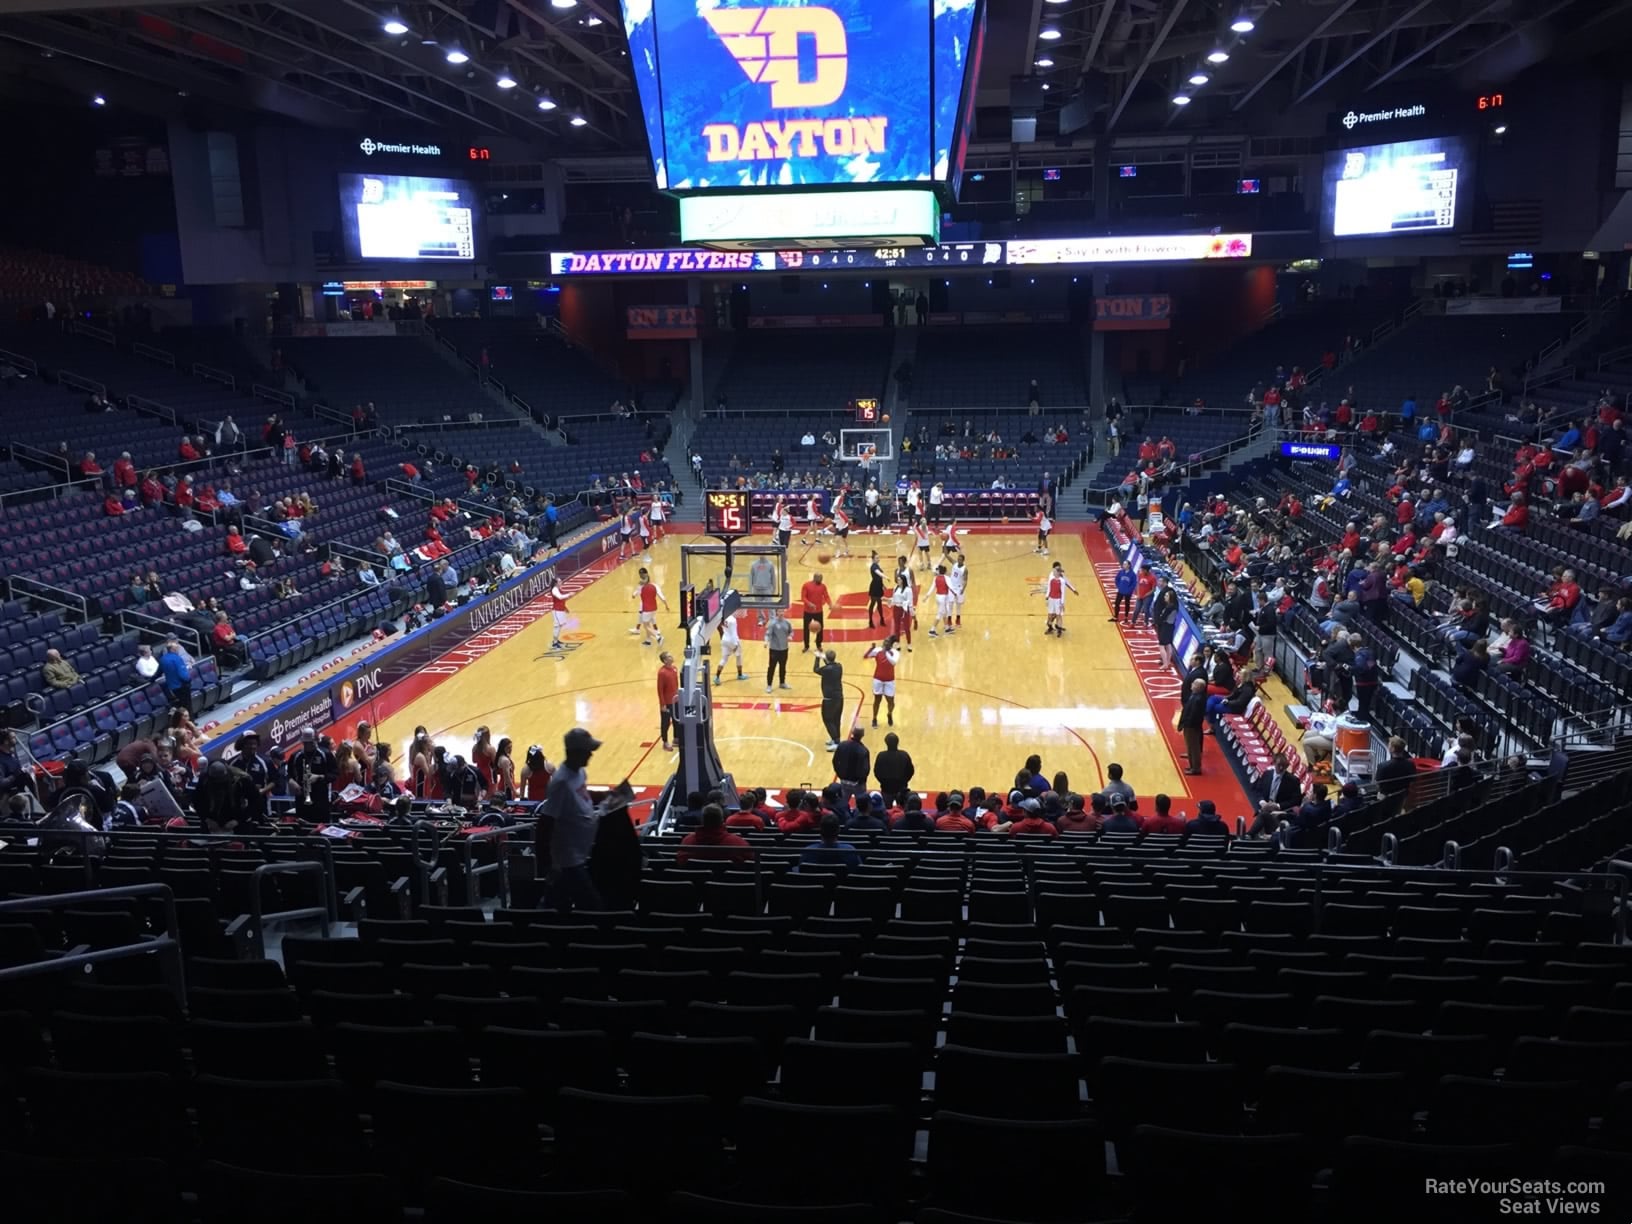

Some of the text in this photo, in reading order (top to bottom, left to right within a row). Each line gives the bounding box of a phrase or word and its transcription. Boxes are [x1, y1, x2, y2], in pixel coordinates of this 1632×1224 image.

[1478, 95, 1502, 109] 6:17
[1359, 105, 1425, 123] Premier Health
[376, 142, 441, 155] Premier Health
[701, 116, 888, 162] DAYTON
[570, 252, 753, 271] DAYTON FLYERS
[875, 248, 906, 259] 42:51
[709, 494, 745, 507] 42:51
[723, 508, 741, 529] 15
[470, 583, 524, 631] UNIVERSITY
[529, 565, 556, 597] DAYTON
[355, 668, 383, 698] PNC
[284, 697, 333, 732] Premier Health
